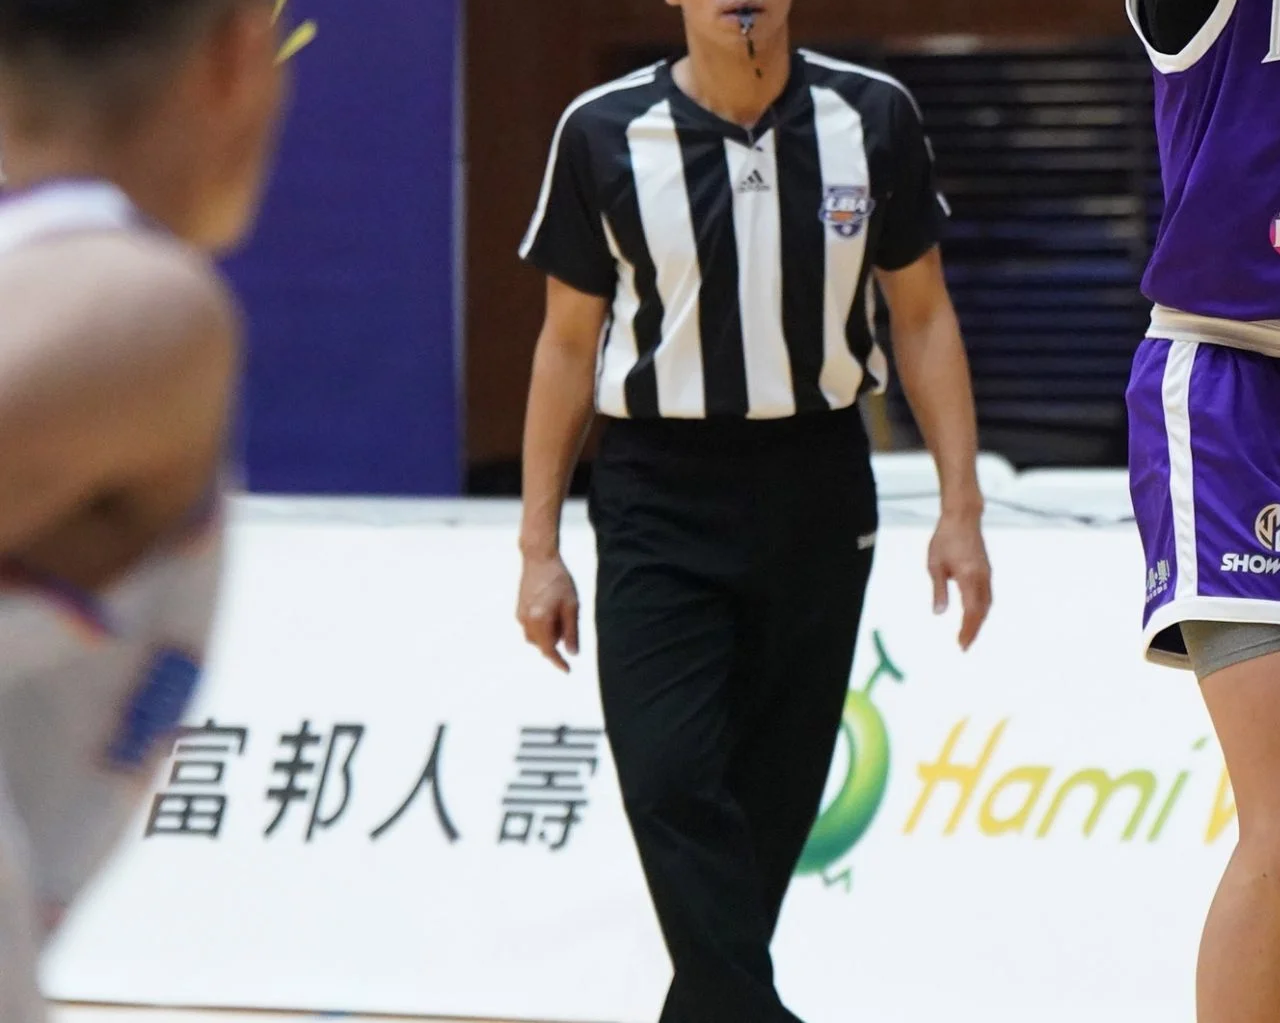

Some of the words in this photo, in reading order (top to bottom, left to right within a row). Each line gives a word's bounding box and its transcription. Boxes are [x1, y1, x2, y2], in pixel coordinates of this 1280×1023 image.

[143, 719, 608, 851] 富邦人壽
[899, 716, 1210, 843] Hami
